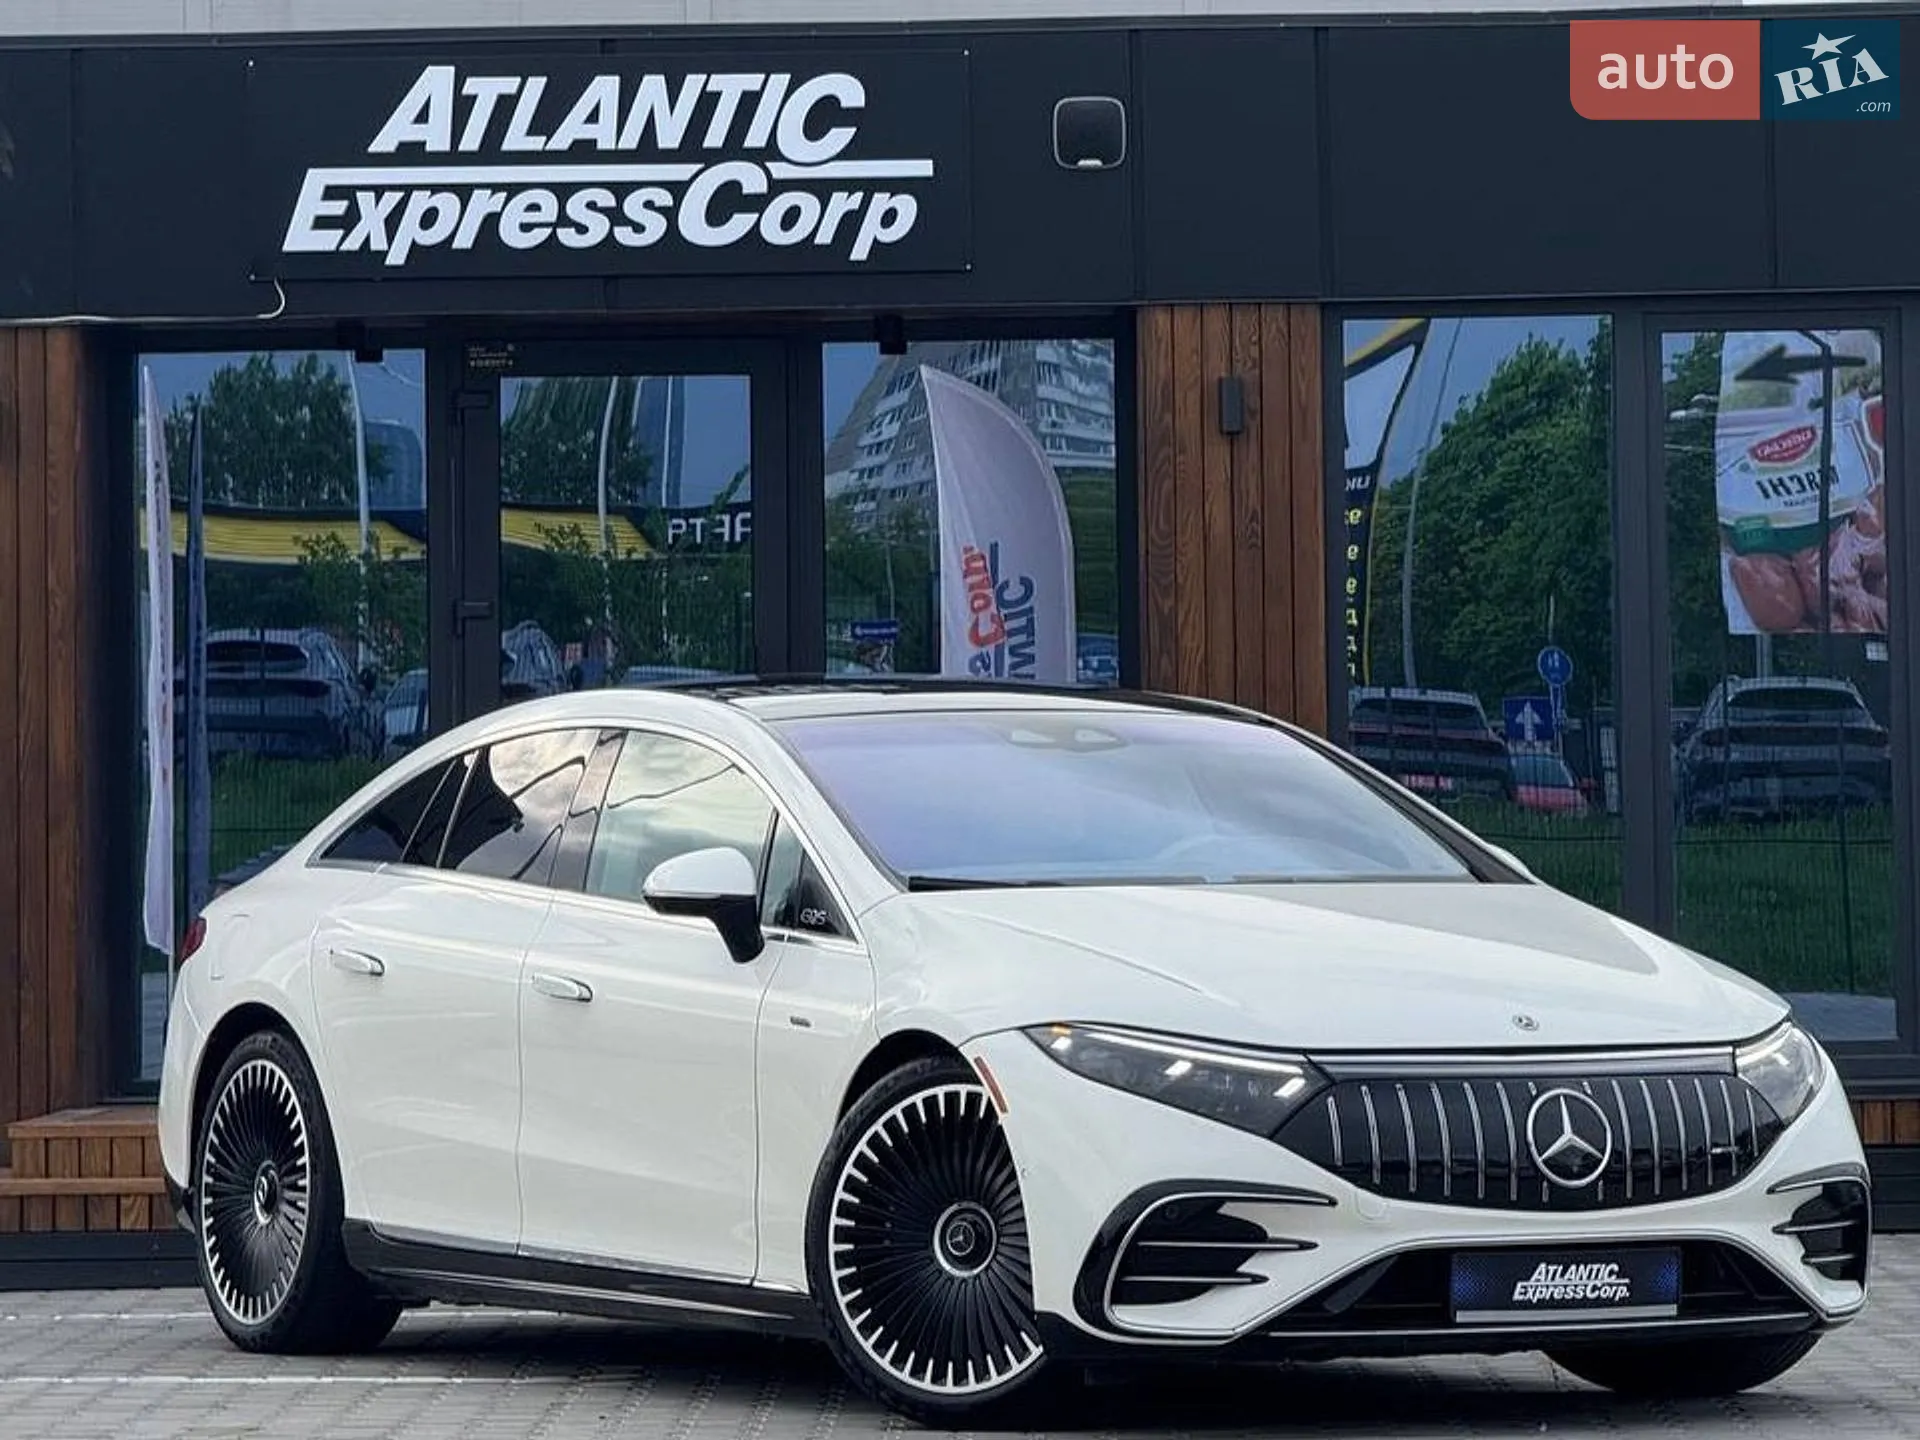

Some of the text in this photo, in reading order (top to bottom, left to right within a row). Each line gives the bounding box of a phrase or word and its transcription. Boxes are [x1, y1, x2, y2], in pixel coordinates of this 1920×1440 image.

[367, 65, 866, 165] ATLANTIC
[282, 161, 918, 266] ExpressCorp
[1512, 1281, 1631, 1303] ExpressCorp.
[1530, 1262, 1620, 1282] ATLANTIC
